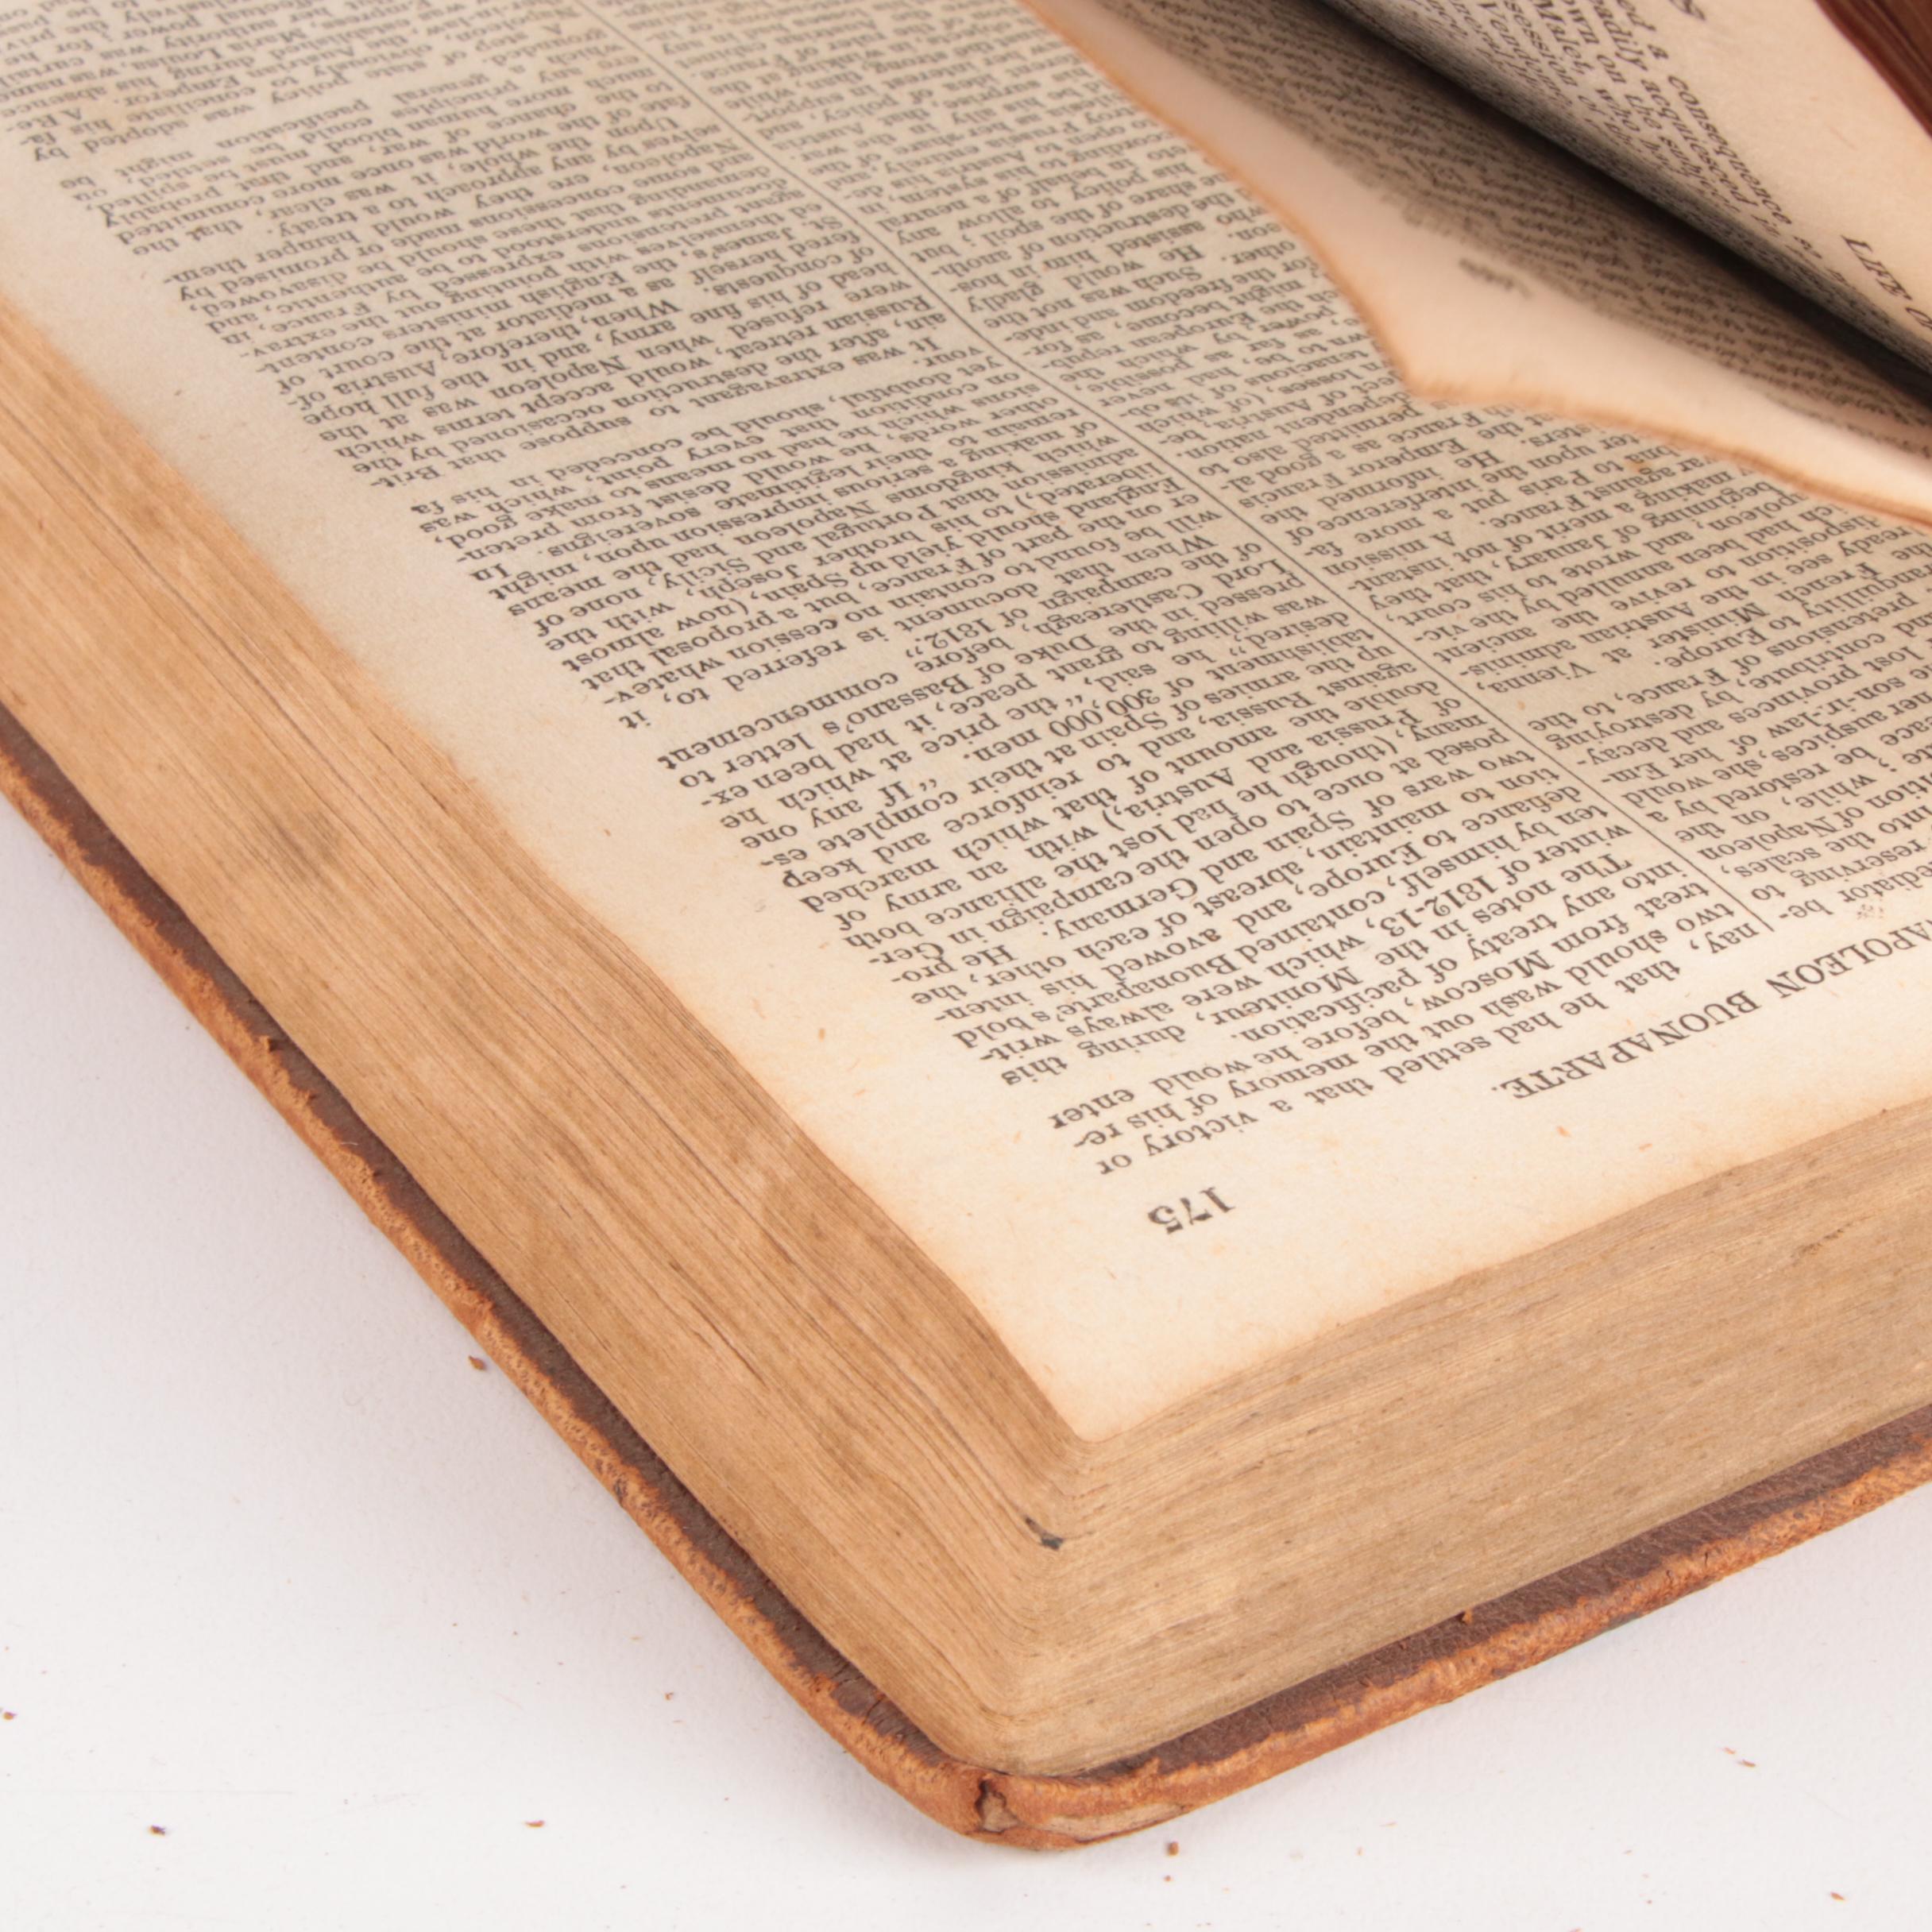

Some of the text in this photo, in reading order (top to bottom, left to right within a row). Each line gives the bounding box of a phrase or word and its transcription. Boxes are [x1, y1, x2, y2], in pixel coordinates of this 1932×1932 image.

[1595, 87, 1640, 133] who
[1596, 52, 1663, 131] on the
[1640, 78, 1759, 208] acquiesced
[1668, 74, 1792, 226] consequence
[967, 244, 1204, 313] He would gladly
[983, 240, 1296, 328] other. Such was not the
[1840, 234, 1913, 302] LIFE
[318, 280, 912, 442] were refused when Napoleon was at the
[369, 336, 940, 488] It was extravagant to suppose that Brit-
[1238, 421, 1524, 508] the Emperor Francis
[507, 435, 1119, 616] which kingdoms Napoleon had the means
[1232, 542, 1262, 562] of
[1037, 566, 1173, 609] campaign
[1180, 551, 1229, 570] the
[1385, 531, 1694, 626] and wrote to his court,
[1775, 562, 1880, 607] French
[998, 608, 1028, 628] of
[1648, 601, 1769, 649] Minister
[1663, 615, 1801, 667] to Europe.
[656, 558, 1287, 770] Lord Castlereagh, before commencement
[1205, 628, 1374, 681] tablishment
[1475, 661, 1596, 693] Vienna,
[1527, 591, 1918, 731] pretensions of France, to the
[1600, 647, 1633, 664] at
[1048, 688, 1160, 736] 300,000
[1163, 677, 1194, 697] of
[963, 728, 1041, 761] men.
[740, 824, 798, 848] one
[810, 799, 863, 828] any
[837, 697, 1461, 931] of Prussia and Austria,) with an army of
[1514, 821, 1559, 841] by
[1554, 799, 1608, 825] ten
[1674, 774, 1876, 842] while, on the
[1696, 806, 1864, 860] of Napoleon
[1387, 834, 1520, 897] himself,
[1720, 847, 1822, 877] scales,
[1750, 839, 1926, 900] reserving to
[1824, 831, 1876, 852] the
[910, 767, 1559, 1004] tion to maintain, abreast of each other, the
[980, 824, 1632, 1061] winter of 1812-13, which were always writ-
[1231, 860, 1682, 1041] into any treaty of pacification.
[1234, 890, 1385, 964] contained
[1000, 842, 1621, 1086] The notes in the Moniteur, during this
[952, 1016, 1034, 1049] bold
[1047, 882, 1709, 1130] treat from Moscow, before he would enter
[1073, 902, 1734, 1148] two should wash out the memory of his re-
[1095, 922, 1760, 1174] nay, that he had settled that a victory or
[1490, 990, 1760, 1099] BUONAPARTE.
[1146, 1187, 1235, 1235] 175
